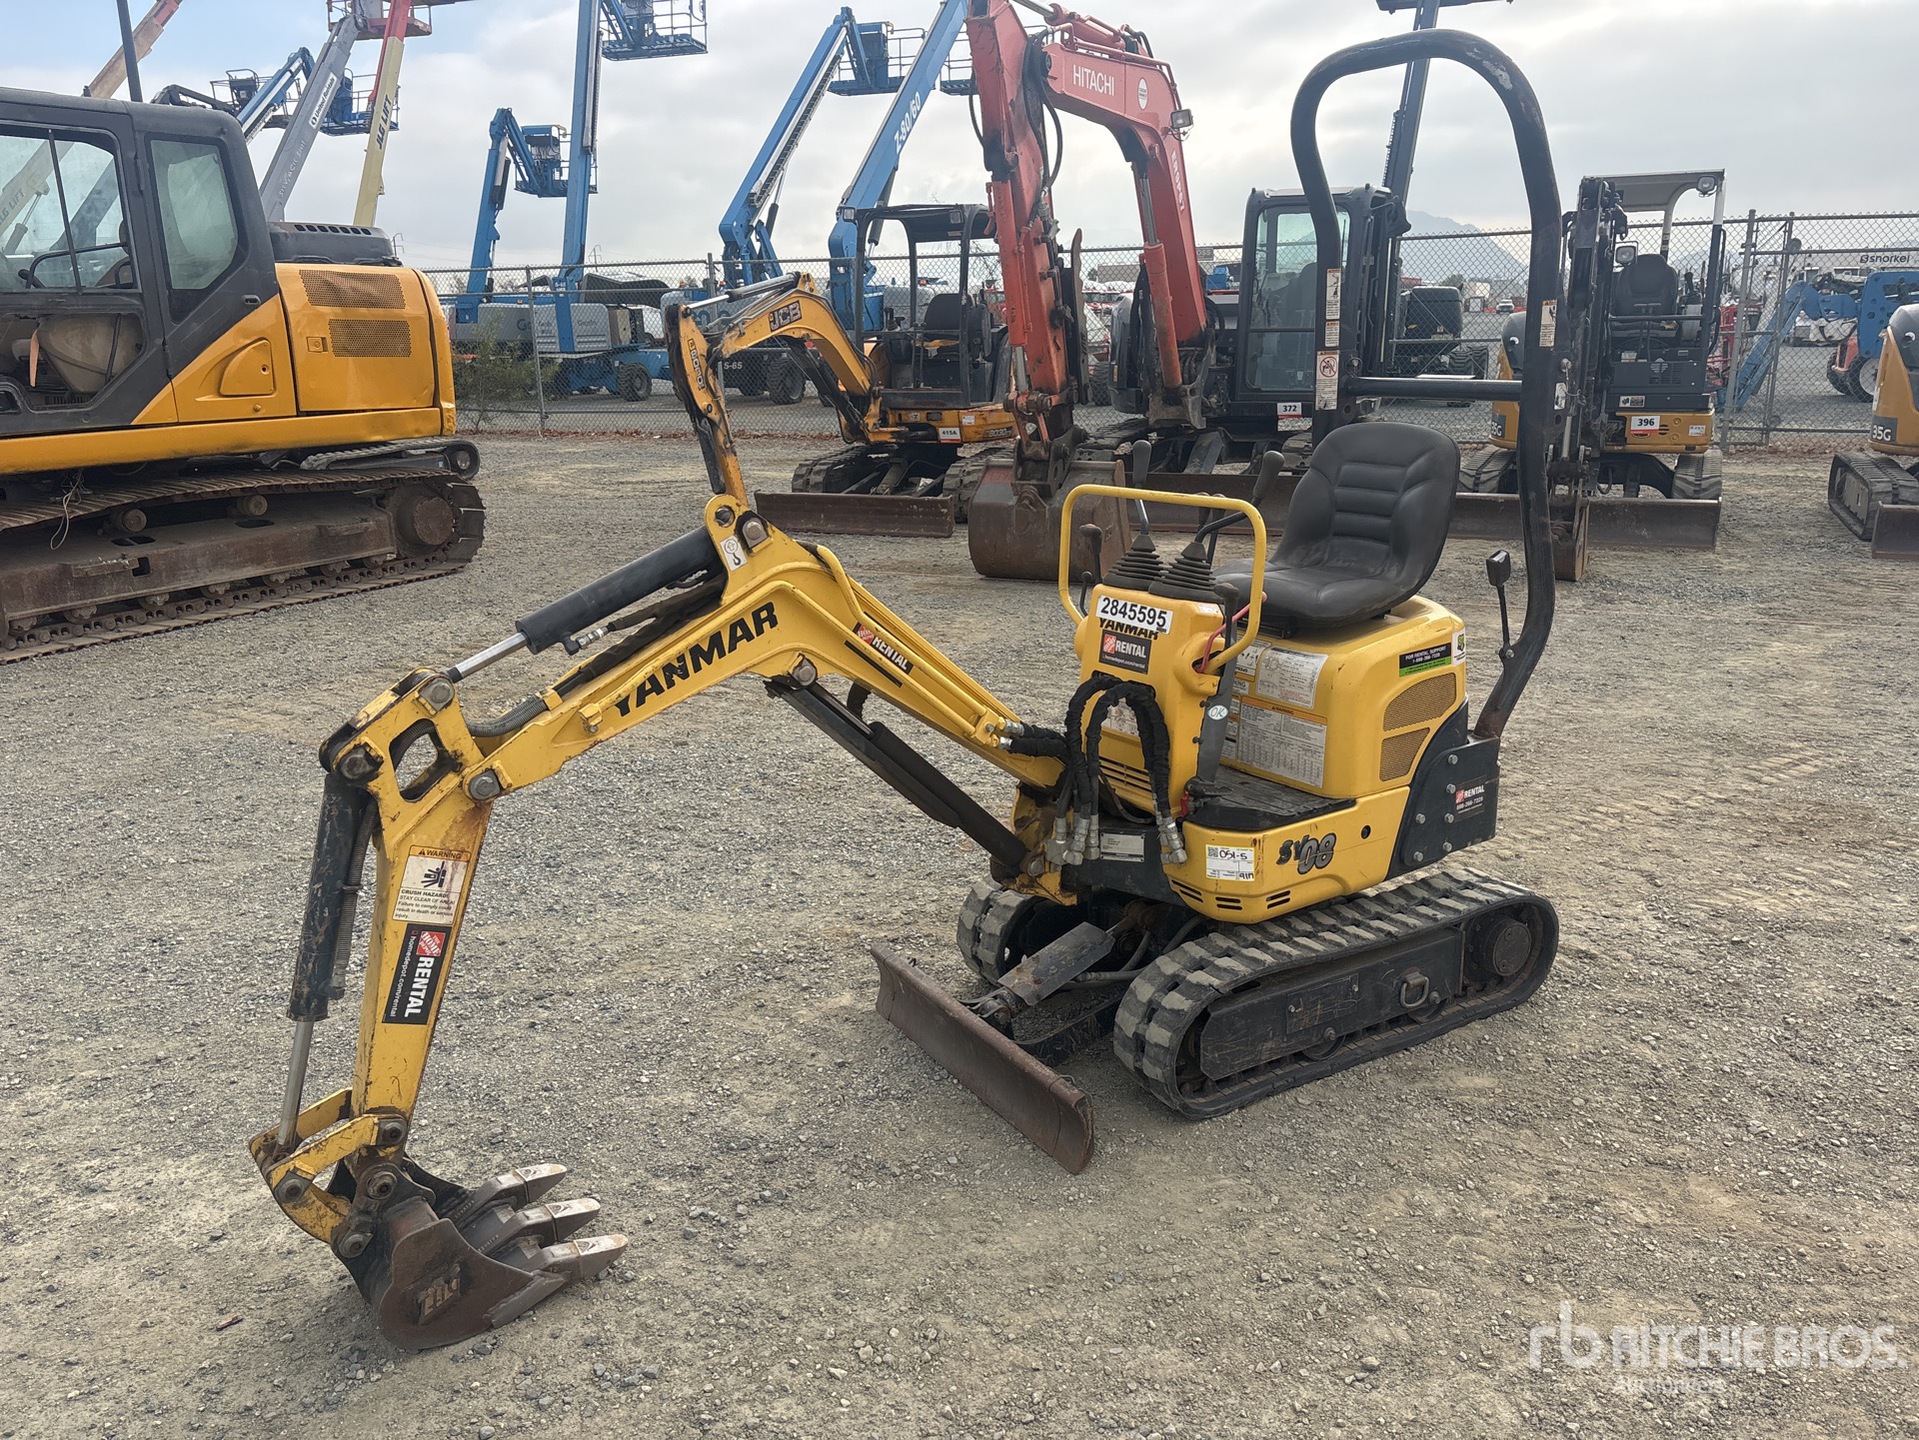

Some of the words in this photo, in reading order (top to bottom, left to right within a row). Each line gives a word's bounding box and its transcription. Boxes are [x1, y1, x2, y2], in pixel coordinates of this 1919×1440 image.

[1073, 64, 1115, 96] HITACHI
[314, 96, 327, 119] United
[376, 123, 386, 150] JLG
[381, 93, 393, 126] LIFT
[894, 91, 921, 154] Z-80/60
[9, 187, 25, 210] LIFT
[1869, 254, 1911, 264] snorkel
[770, 302, 802, 331] JCB
[723, 361, 743, 370] S-65
[1282, 405, 1297, 413] 372
[1637, 418, 1655, 427] 396
[1100, 597, 1168, 628] 2845595
[1099, 617, 1160, 640] YANMAR
[615, 602, 778, 717] YANMAR
[872, 636, 909, 670] RENTAL
[1115, 640, 1147, 658] RENTAL
[1210, 707, 1226, 717] OK
[1464, 785, 1485, 799] RENTAL
[427, 850, 462, 860] WARNING
[401, 888, 422, 896] CRUSH
[421, 931, 441, 956] HOME
[389, 935, 417, 1018] homedepot.com/rental
[404, 956, 435, 1018] RENTAL
